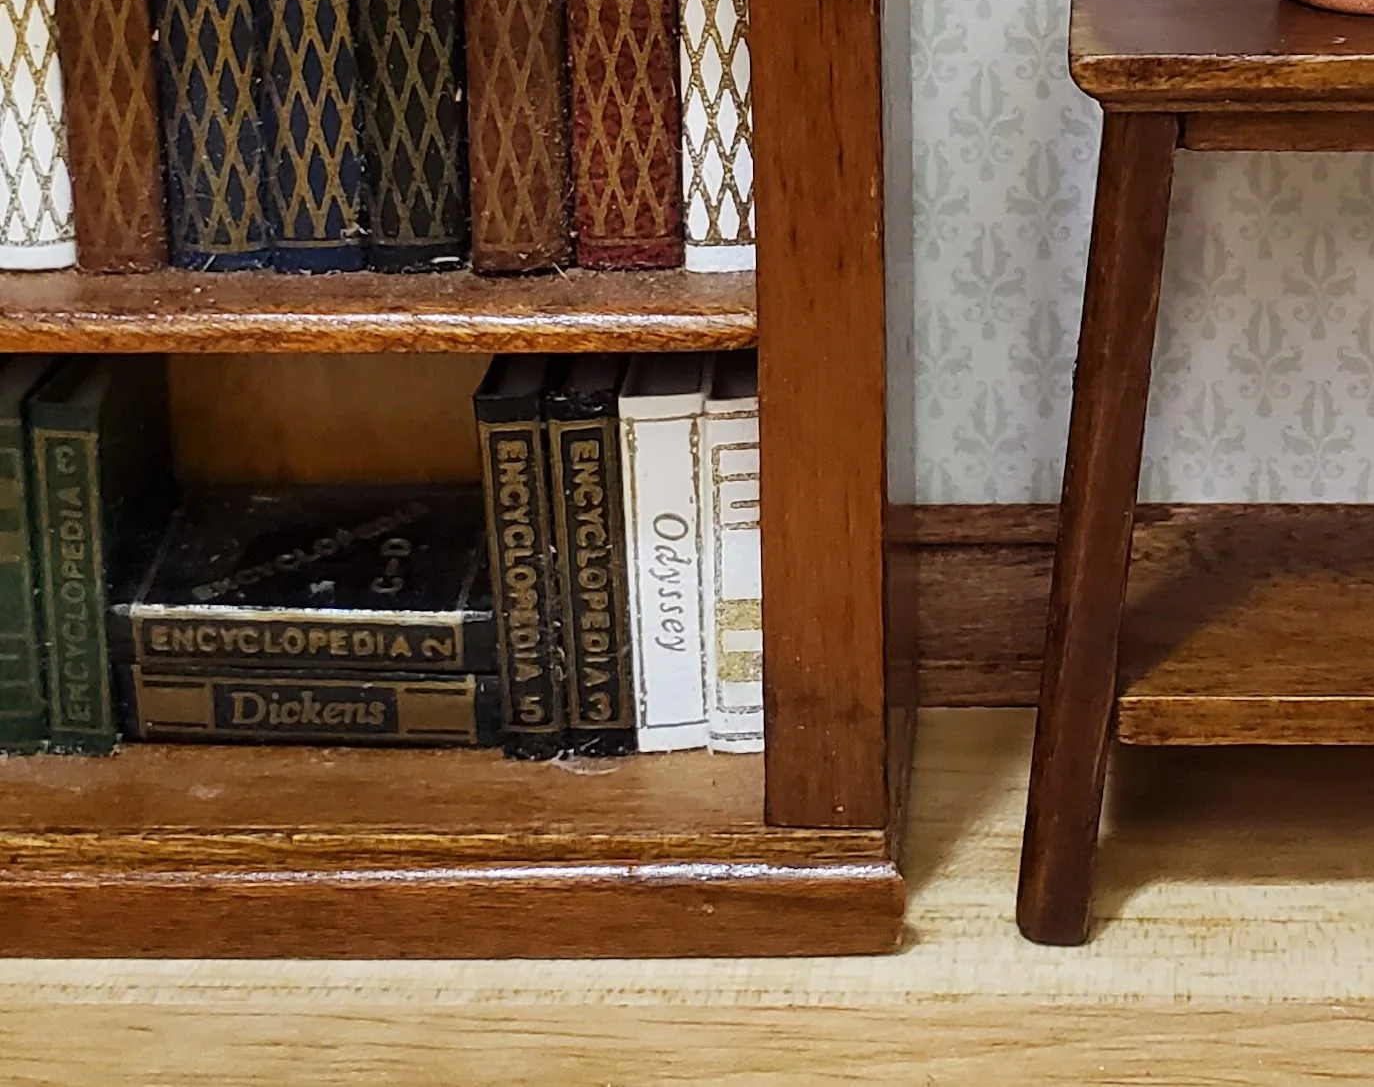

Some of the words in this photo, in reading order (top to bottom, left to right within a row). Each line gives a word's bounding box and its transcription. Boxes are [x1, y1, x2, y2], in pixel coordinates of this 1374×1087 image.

[56, 486, 92, 722] ENCYCLOPEDIA
[496, 439, 542, 682] ENCYCLOPEDIA
[519, 696, 544, 722] 5
[570, 439, 611, 687] ENCYCLOPEDIA
[650, 513, 692, 652] Odyssey
[151, 624, 412, 657] ENCYCLOPEDIA
[420, 635, 453, 657] 2
[230, 690, 387, 726] Dickens
[588, 691, 614, 721] 3
